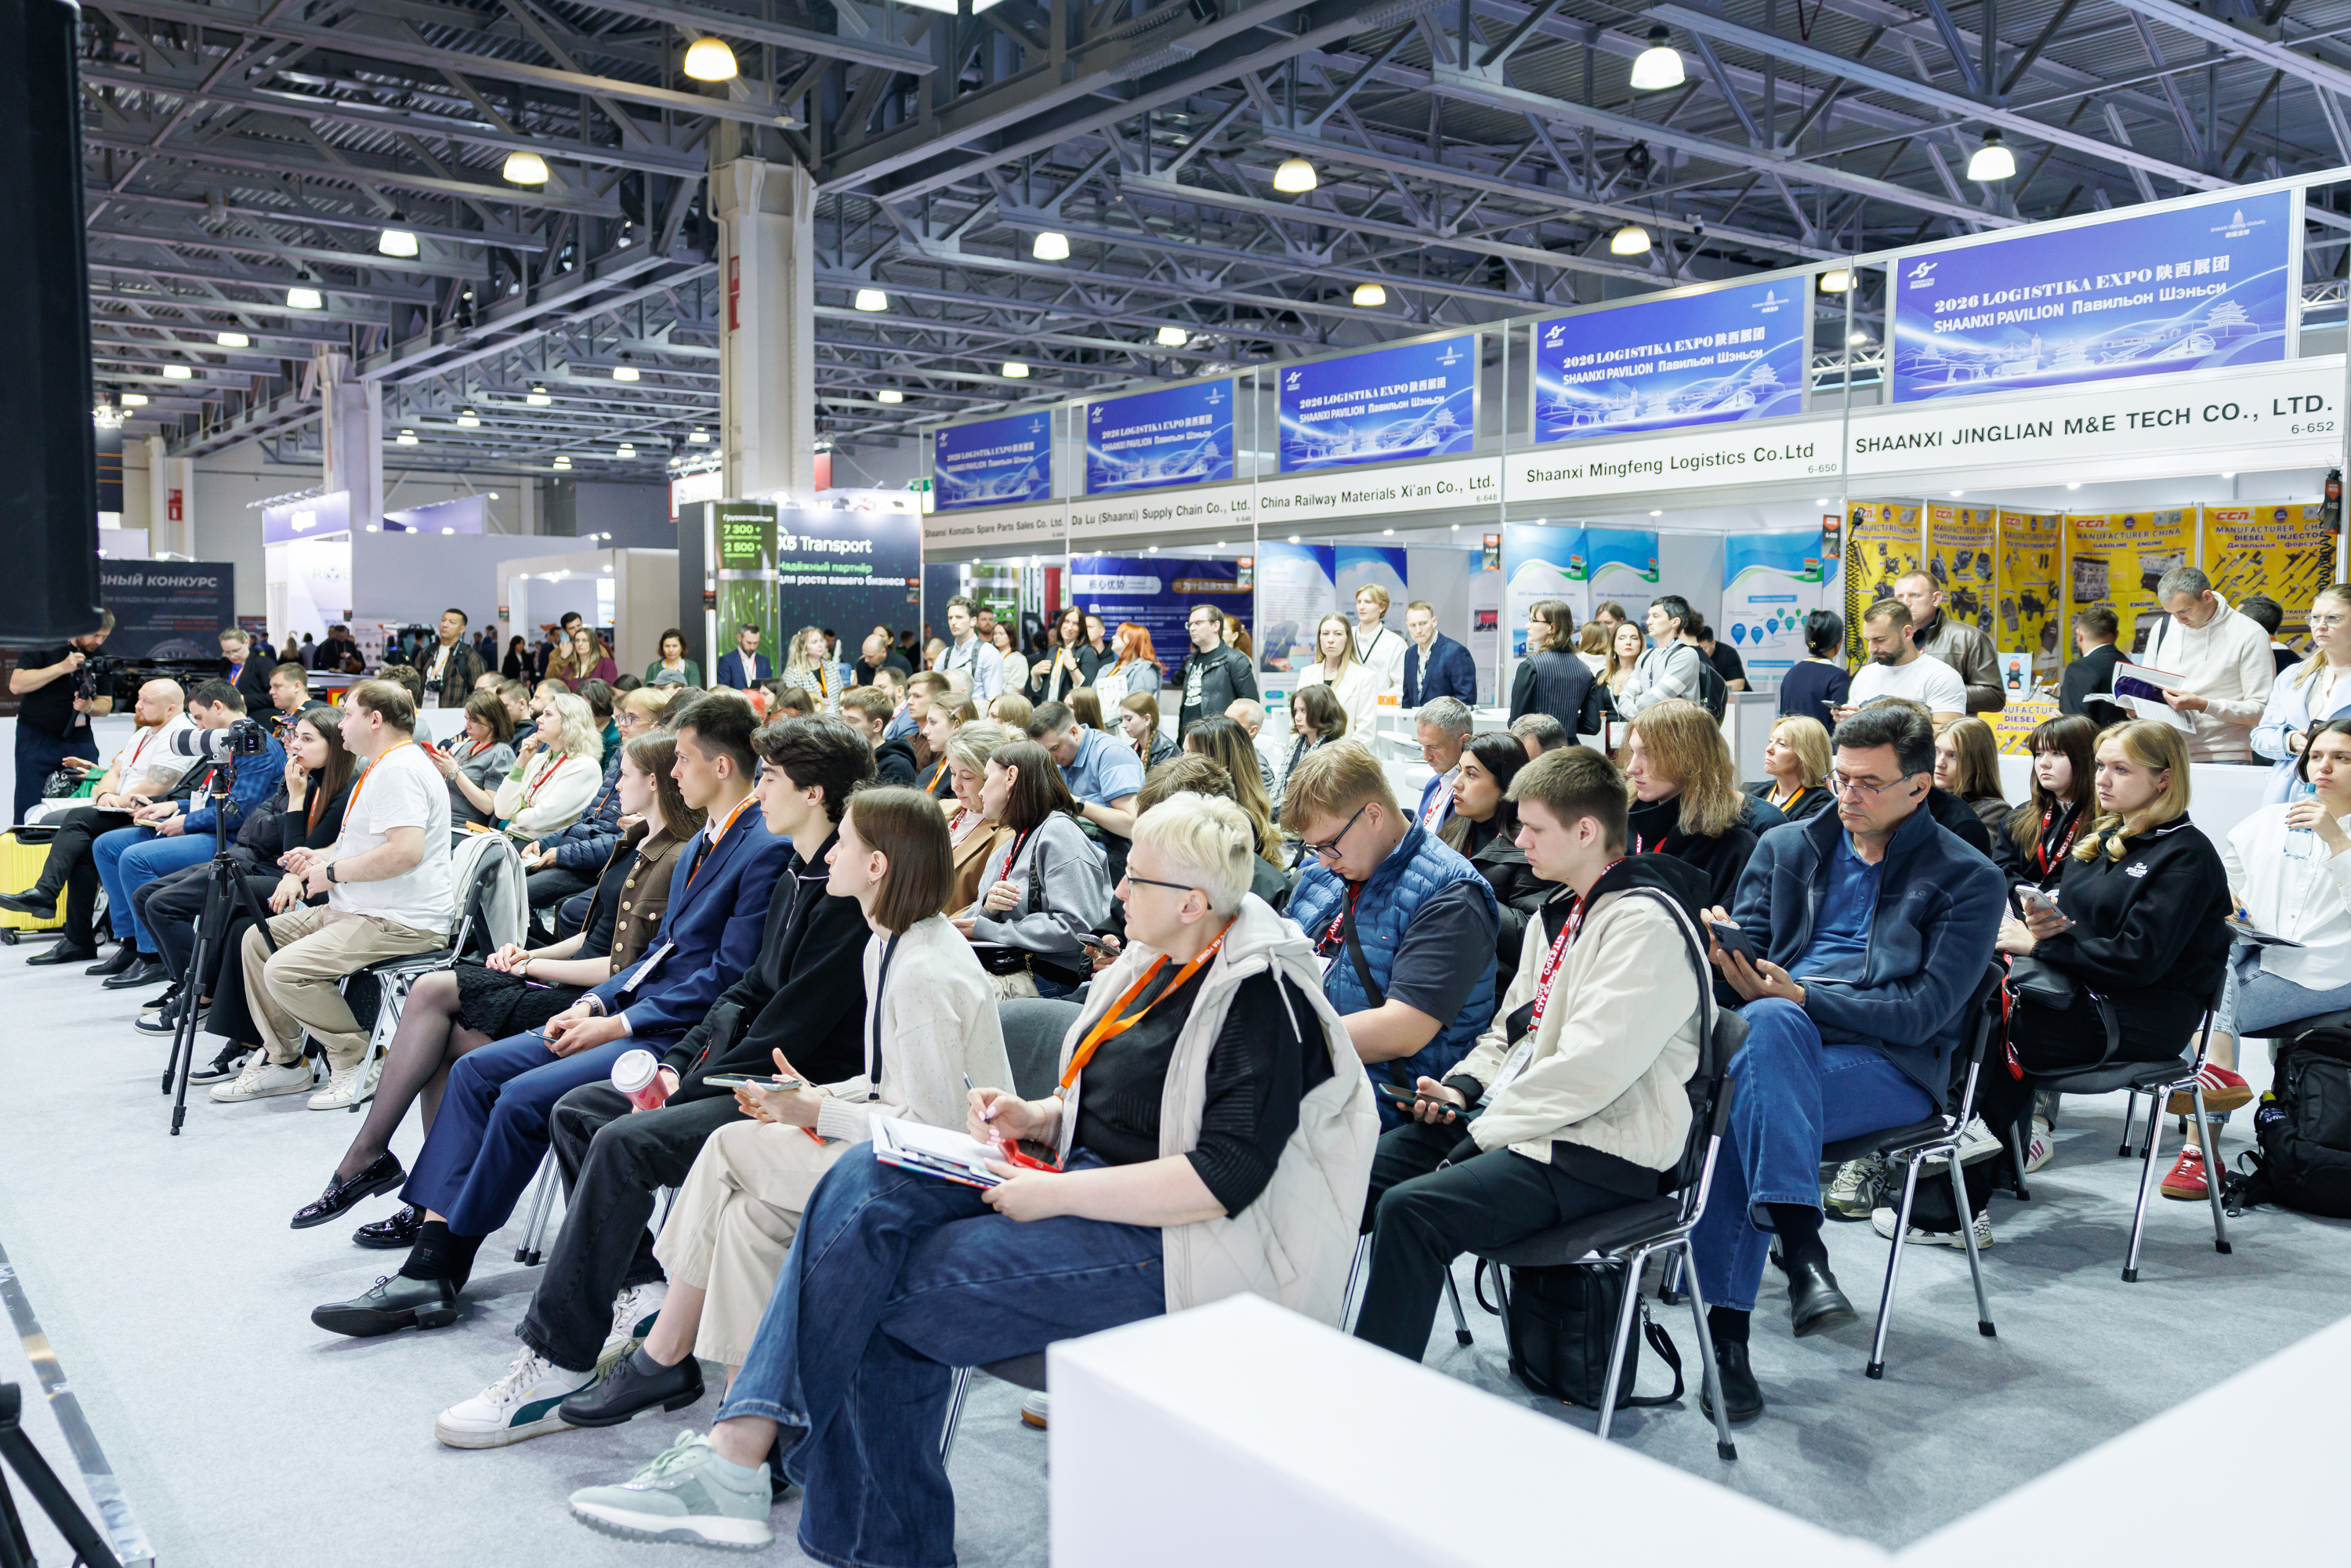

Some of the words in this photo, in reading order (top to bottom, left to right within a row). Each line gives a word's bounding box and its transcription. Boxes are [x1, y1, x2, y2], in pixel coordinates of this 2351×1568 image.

[1934, 295, 1979, 313] 2026
[1982, 277, 2093, 307] LOGISTIKA
[2096, 268, 2152, 289] EXPO
[2156, 255, 2230, 282] 陕西展团
[1933, 313, 1994, 334] SHAANXI
[1997, 303, 2064, 324] PAVILION
[2072, 292, 2153, 314] Павильон
[2159, 282, 2226, 302] Шэньси
[1563, 353, 1595, 368] 2026
[1596, 342, 1672, 364] LOGISTIKA
[1674, 335, 1713, 351] EXPO
[1715, 326, 1765, 347] 陕西展团
[1563, 369, 1605, 386] SHAANXI
[1607, 362, 1654, 380] PAVILION
[1658, 355, 1714, 372] Павильон
[1717, 349, 1763, 364] Шэньси
[1299, 397, 1323, 409] 2026
[1324, 389, 1378, 406] LOGISTIKA
[1379, 382, 1408, 397] EXPO
[1299, 409, 1330, 424] SHAANXI
[1331, 405, 1364, 419] PAVILION
[1368, 400, 1408, 414] Павильон
[1411, 395, 1444, 407] Шэньси
[1102, 429, 1120, 440] 2026
[1120, 423, 1162, 437] LOGISTIKA
[1163, 418, 1184, 430] EXPO
[1856, 432, 1943, 454] SHAANXI
[1952, 421, 2052, 446] JINGLIAN
[2063, 415, 2116, 436] M&E
[2126, 407, 2191, 429] TECH
[2203, 402, 2259, 424] CO.,
[2273, 394, 2334, 416] LTD.
[2291, 421, 2335, 435] 6-652
[1527, 465, 1583, 483] Shaanxi
[1590, 458, 1663, 477] Mingfeng
[1671, 450, 1746, 472] Logistics
[1754, 443, 1814, 462] Co.Ltd
[1808, 463, 1837, 473] 6-650
[1261, 497, 1291, 509] China
[1295, 494, 1337, 507] Railway
[1342, 487, 1396, 503] Materials
[1401, 484, 1431, 498] Xi'an
[1436, 481, 1463, 494] Co.,
[1469, 475, 1495, 490] Ltd.
[1476, 494, 1498, 502] 6-648
[1072, 516, 1082, 526] Da
[1085, 514, 1095, 524] Lu
[1099, 509, 1139, 524] (Shaanxi)
[1143, 507, 1172, 520] Supply
[1176, 504, 1202, 516] Chain
[1207, 502, 1226, 515] Co.,
[1231, 499, 1251, 512] Ltd.
[723, 524, 731, 534] 7
[732, 524, 754, 534] 300
[977, 524, 994, 534] Spare
[997, 523, 1014, 531] Parts
[1016, 521, 1034, 530] Sales
[1036, 520, 1048, 528] Co.
[1050, 517, 1064, 527] Ltd.
[2077, 531, 2149, 540] MANUFACTURER
[2153, 528, 2181, 538] CHINA
[2215, 524, 2295, 534] MANUFACTURER
[734, 542, 755, 552] 500
[777, 535, 797, 551] X5
[799, 536, 872, 556] Transport
[831, 563, 873, 574] партнёр
[147, 575, 219, 588] КОНКУРС
[797, 576, 828, 586] роста
[828, 576, 864, 586] вашего
[865, 575, 906, 586] бизнеса
[2057, 842, 2070, 857] EXPO
[1329, 913, 1343, 935] SANY
[1553, 934, 1565, 950] CTT
[1544, 949, 1557, 976] EXPO
[1536, 996, 1546, 1013] CTT
[1545, 969, 1558, 995] EXPO
